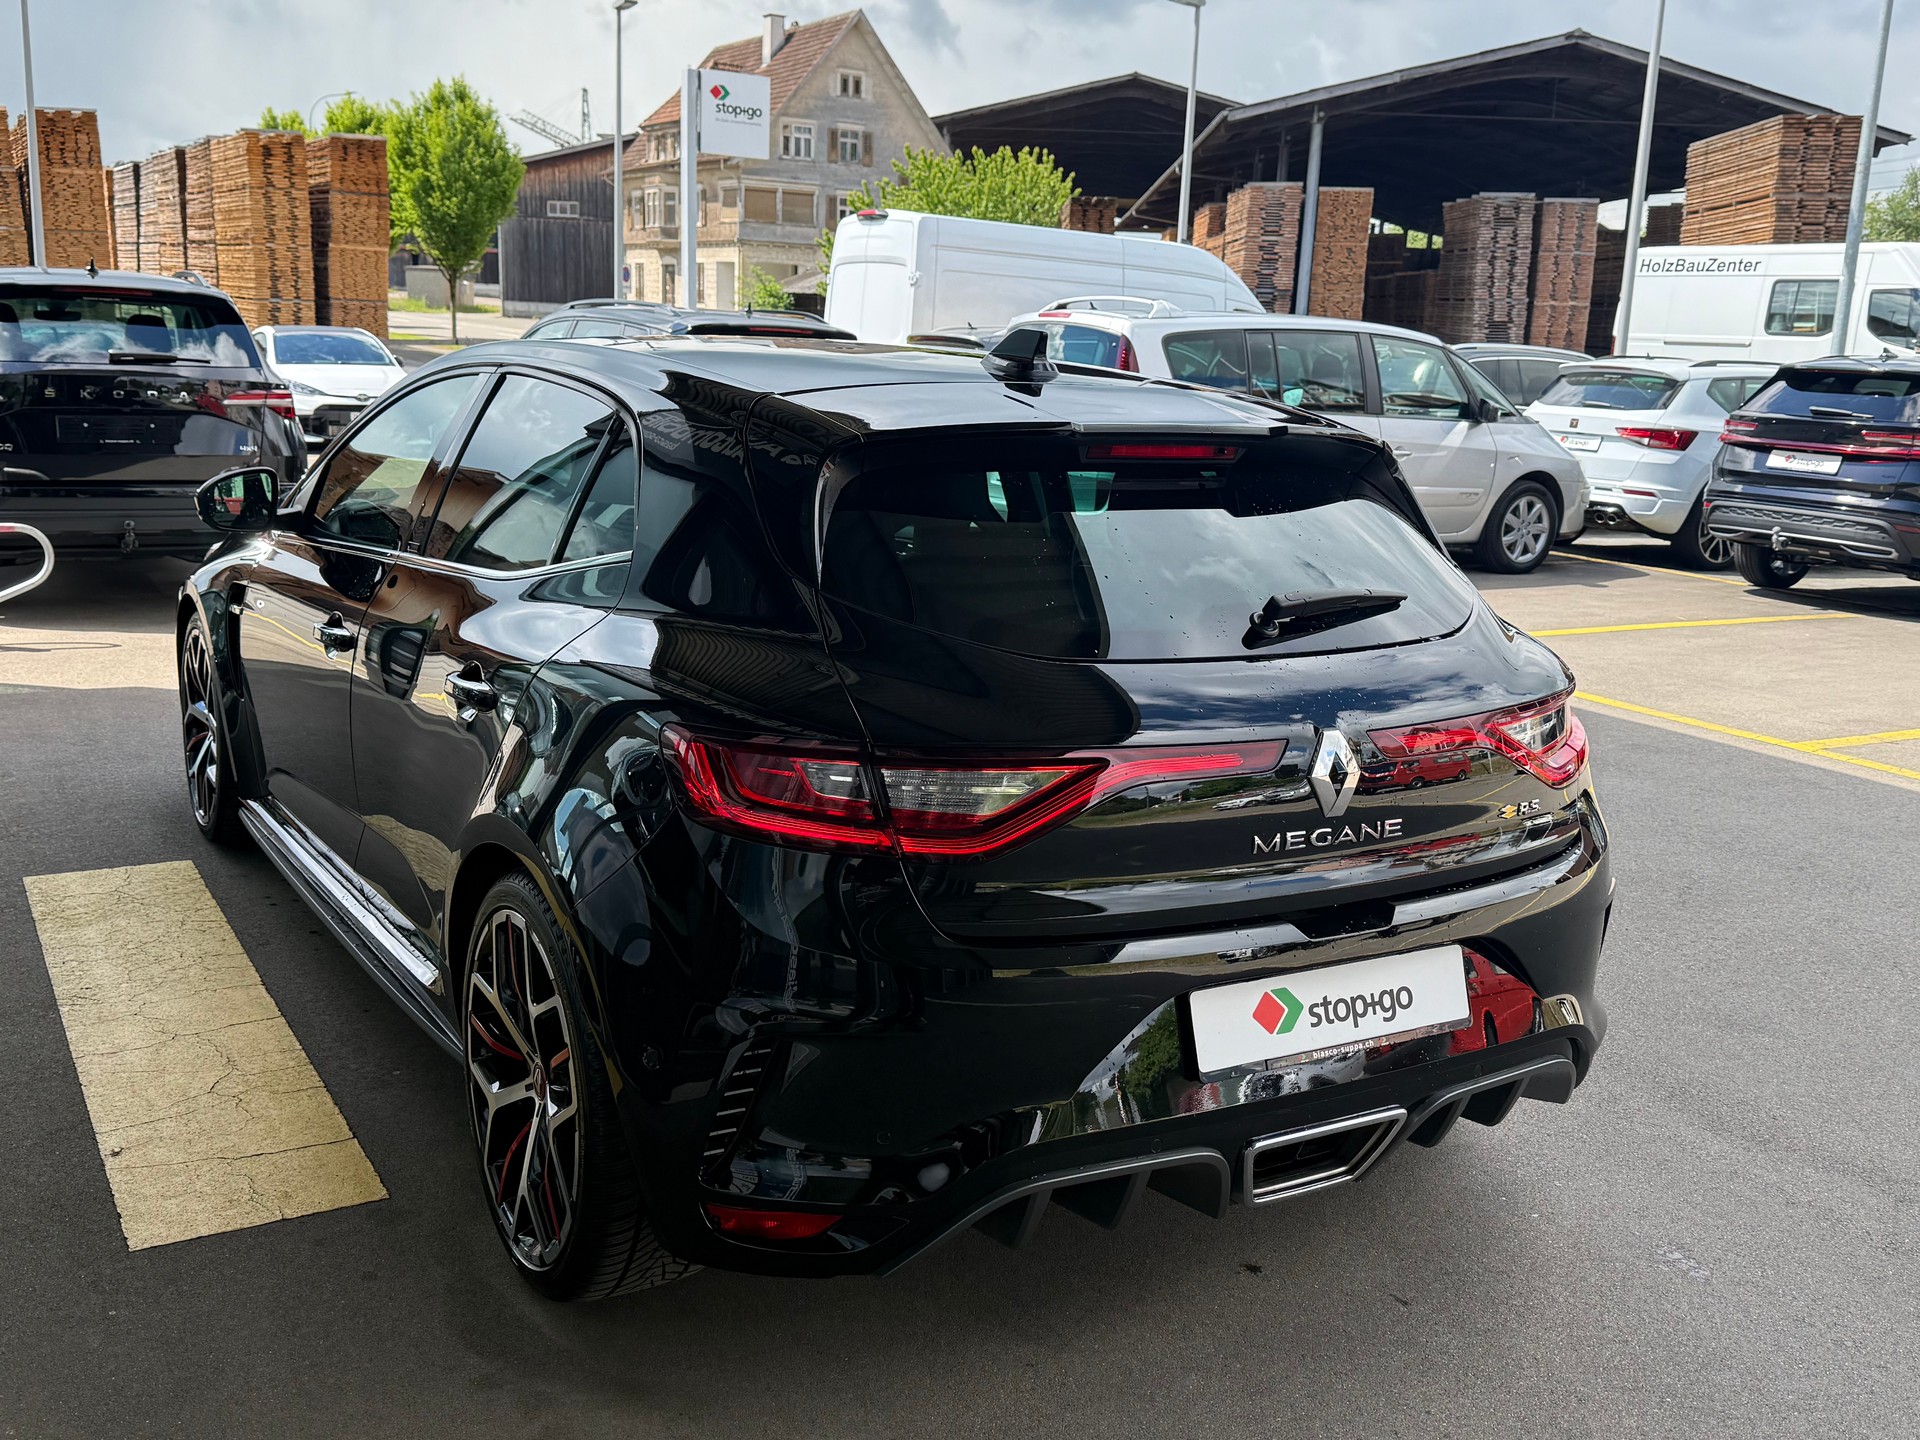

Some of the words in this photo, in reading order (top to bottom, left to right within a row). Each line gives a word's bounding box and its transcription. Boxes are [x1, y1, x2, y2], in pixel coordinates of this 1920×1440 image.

[715, 102, 763, 120] stop+go
[1639, 258, 1762, 273] HolzBauZenter
[1252, 818, 1404, 855] MEGANE
[1308, 984, 1414, 1029] stop+go
[1312, 1039, 1375, 1060] biasco-suppa.ch
